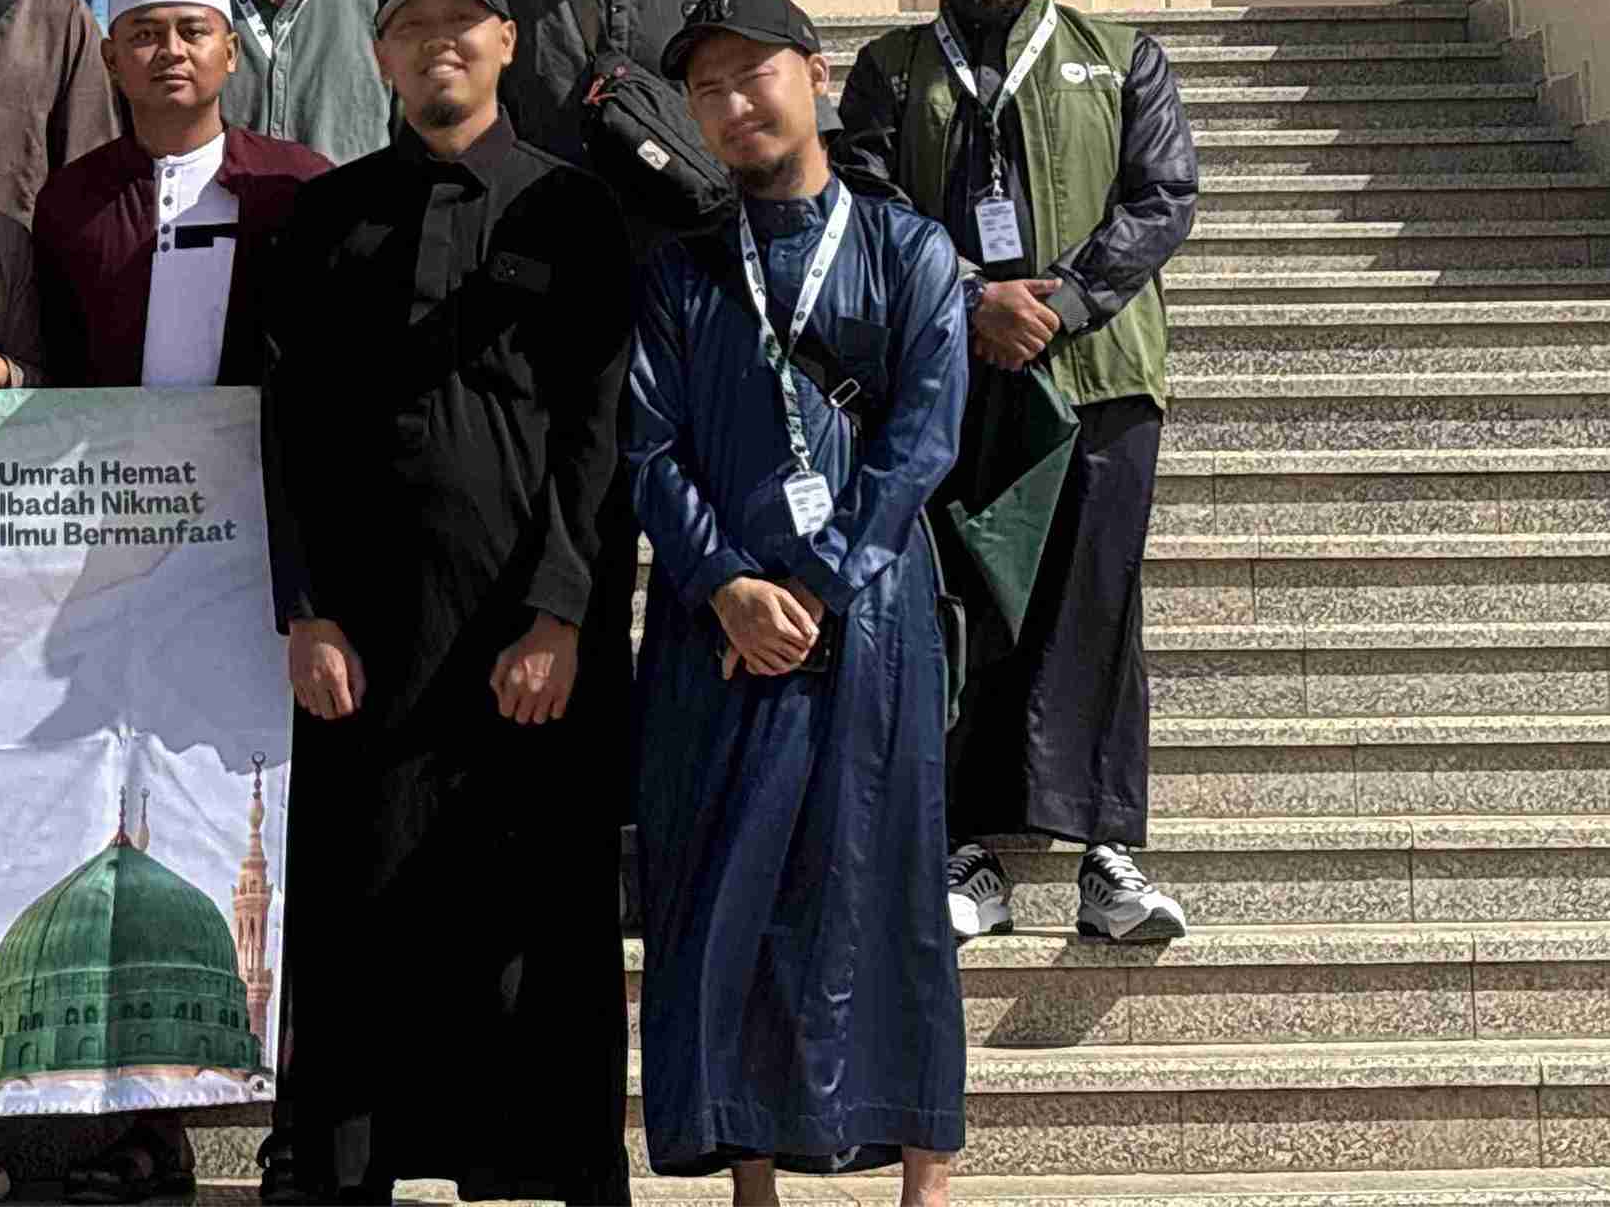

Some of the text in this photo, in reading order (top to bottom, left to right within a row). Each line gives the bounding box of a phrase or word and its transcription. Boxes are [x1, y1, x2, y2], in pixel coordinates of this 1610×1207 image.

[101, 459, 197, 486] Hemat
[0, 488, 206, 517] Ibadah Nikmat
[0, 518, 237, 547] Ilmu Bermanfaat
